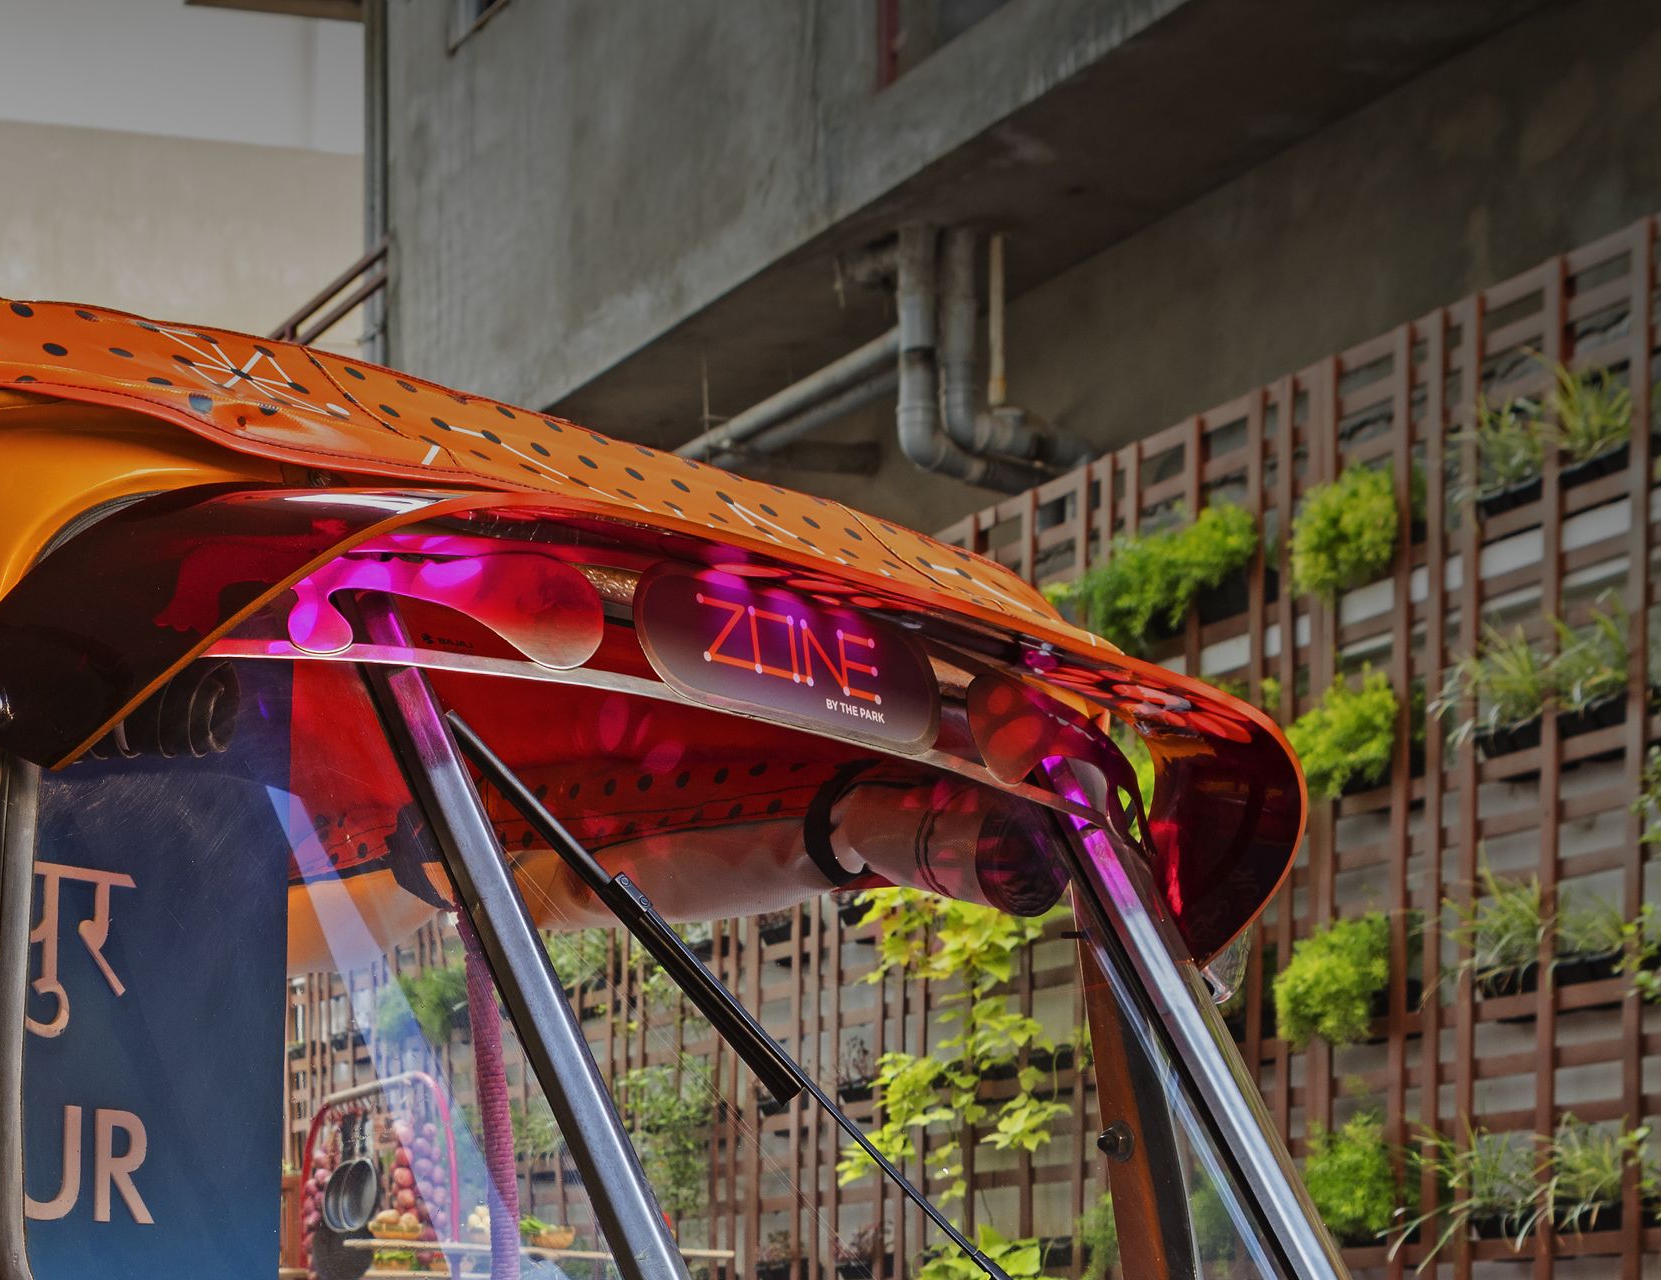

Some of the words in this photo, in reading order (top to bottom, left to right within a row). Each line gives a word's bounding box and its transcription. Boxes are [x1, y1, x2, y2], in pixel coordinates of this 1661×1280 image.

[695, 591, 882, 705] ZONE
[826, 698, 839, 711] BY
[839, 702, 859, 717] THE
[859, 707, 886, 724] PARK
